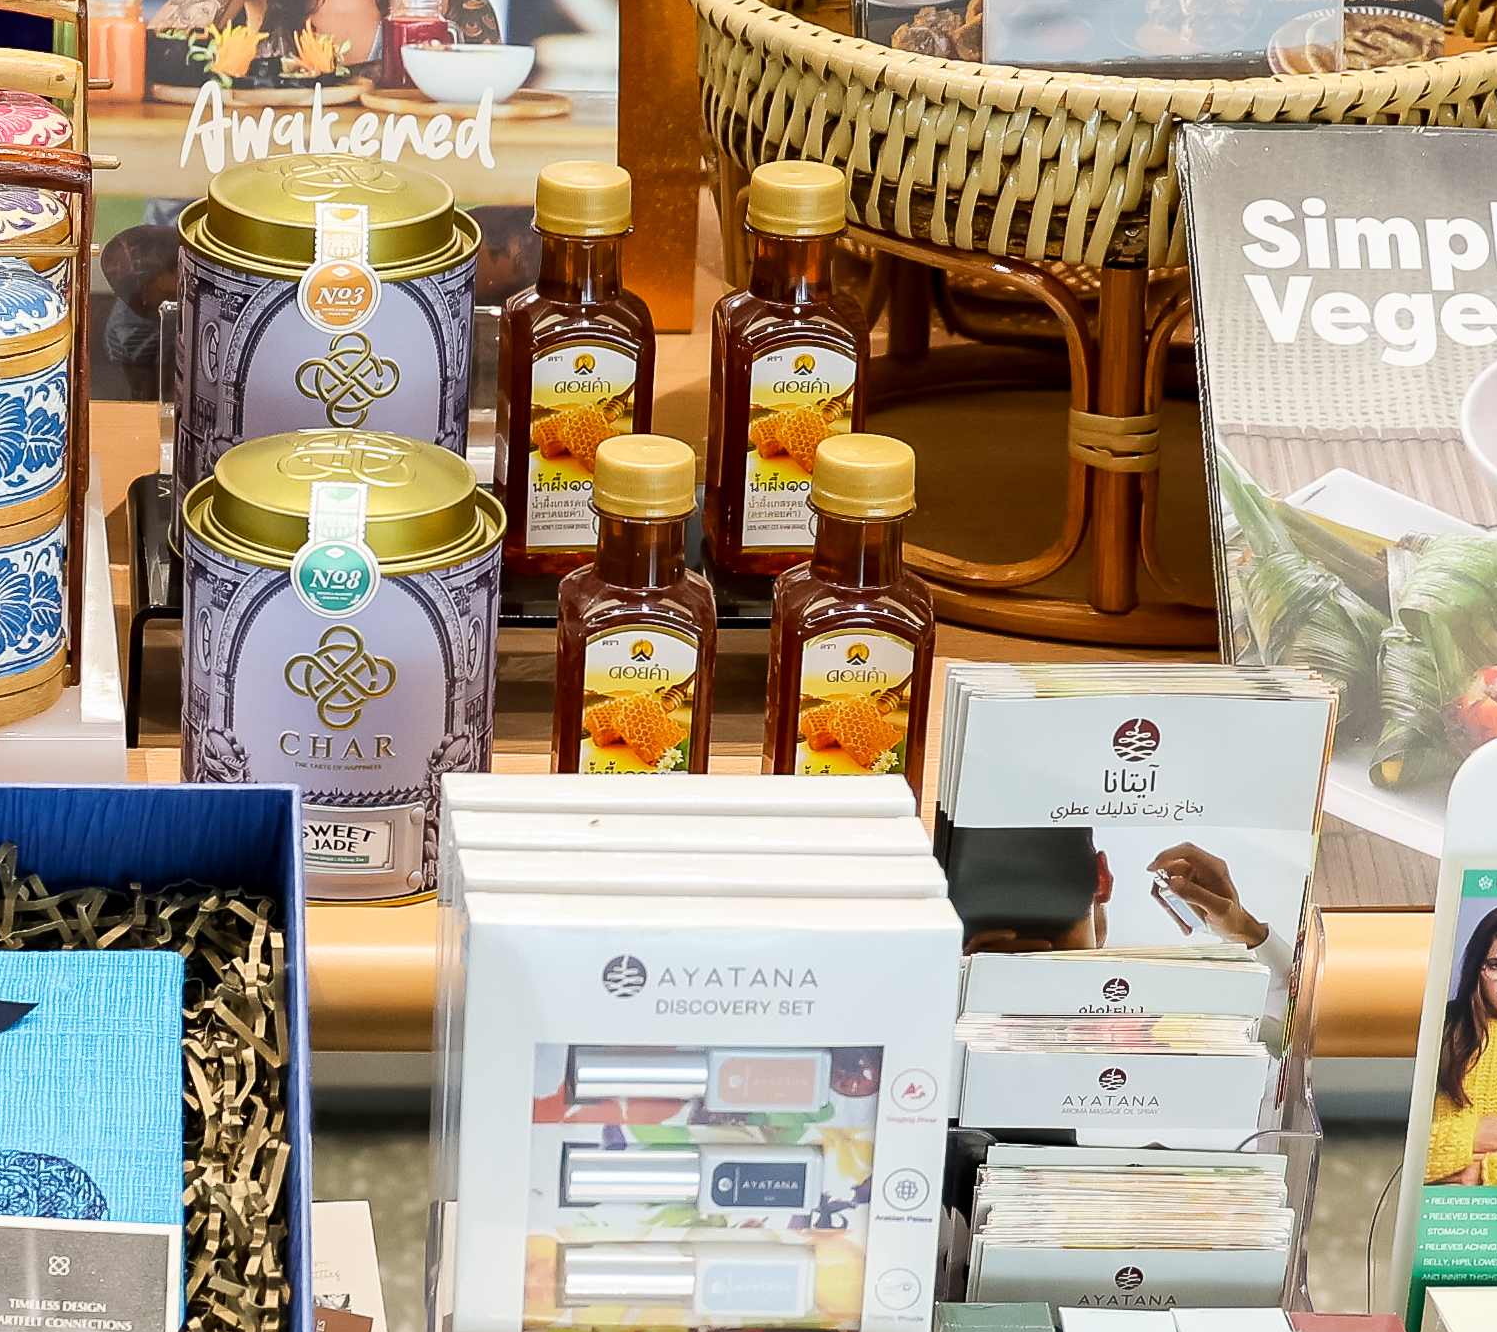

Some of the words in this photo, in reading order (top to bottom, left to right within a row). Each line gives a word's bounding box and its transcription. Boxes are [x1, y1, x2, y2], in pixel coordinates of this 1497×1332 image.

[180, 80, 496, 173] Awakened
[554, 377, 611, 395] ดอยคำ
[532, 472, 593, 494] น้ำผึ้ง๑๐
[609, 662, 670, 682] ดอยคำ
[278, 730, 397, 760] CHAR
[302, 824, 377, 842] SWEET
[312, 839, 360, 853] JADE
[657, 966, 819, 989] AYATANA
[655, 998, 771, 1017] DISCOVERY
[778, 998, 815, 1017] SET
[1061, 1093, 1160, 1108] AYATANA
[1077, 1293, 1178, 1307] AYATANA
